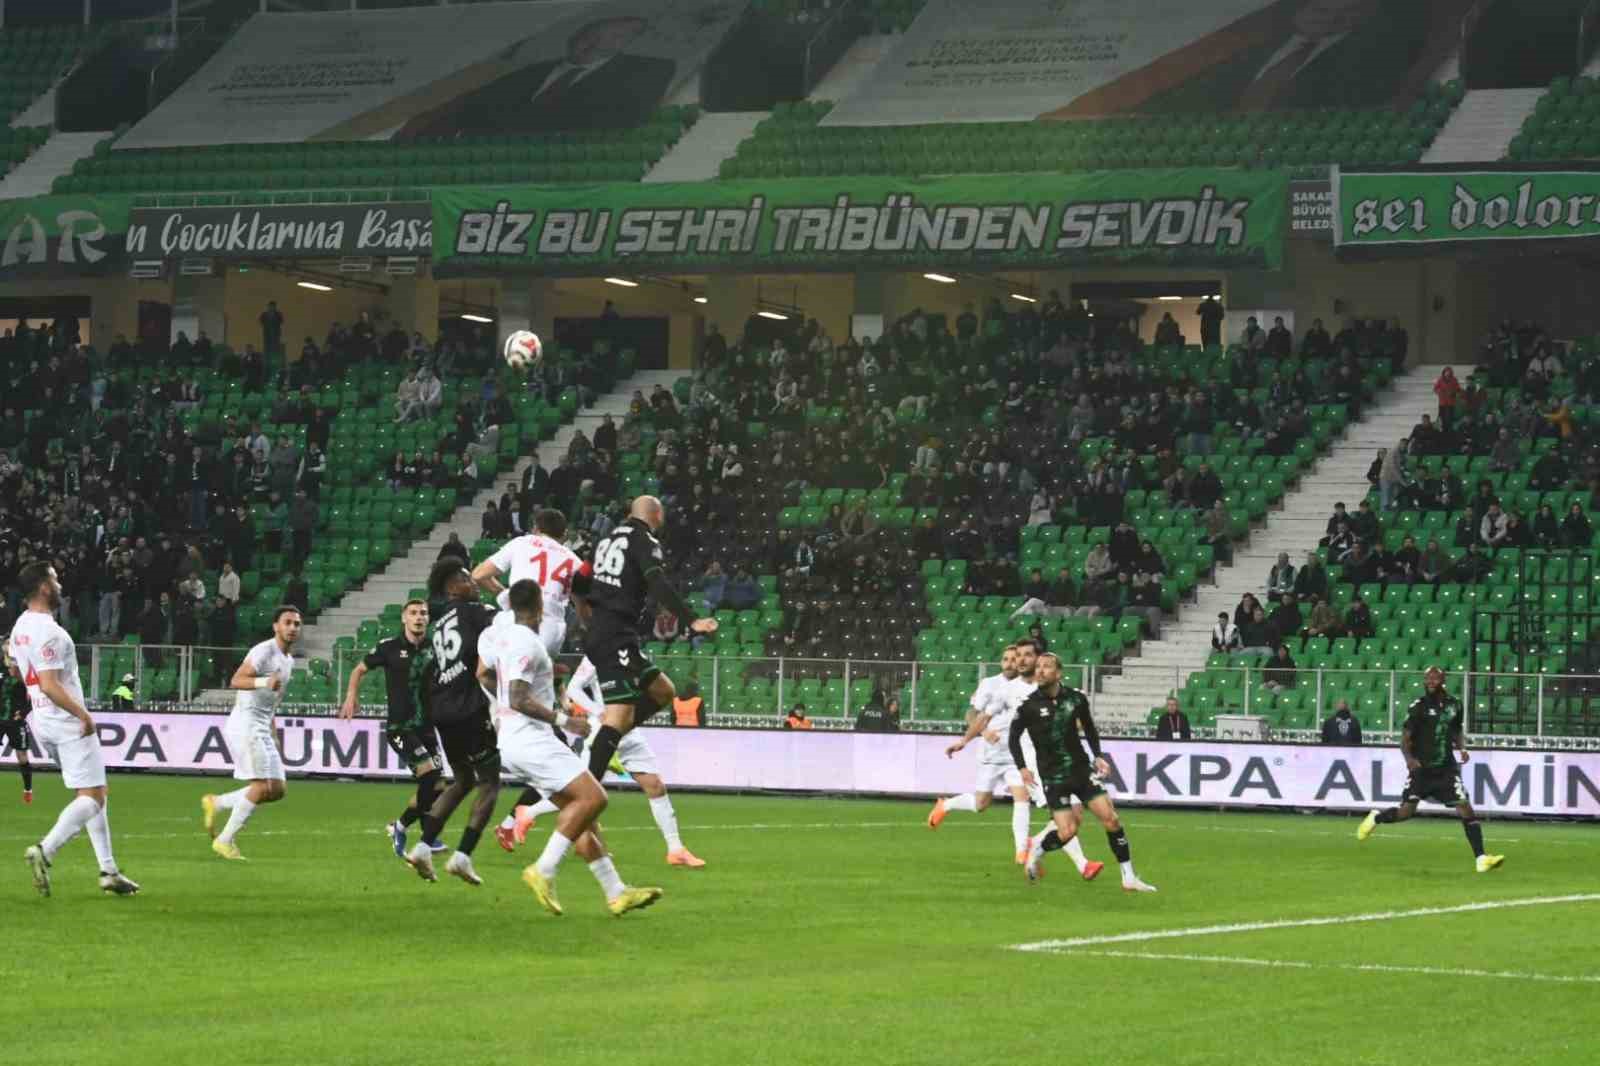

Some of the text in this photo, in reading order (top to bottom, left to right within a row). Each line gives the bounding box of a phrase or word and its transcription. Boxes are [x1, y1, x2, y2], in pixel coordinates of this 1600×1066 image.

[457, 202, 534, 253] BİZ
[539, 209, 609, 254] BU
[774, 196, 1049, 252] TRİBÜNDEN
[1058, 188, 1249, 248] SEVDİK
[530, 551, 574, 594] 14
[1, 723, 166, 762] APA
[1315, 754, 1600, 808] ALMİN
